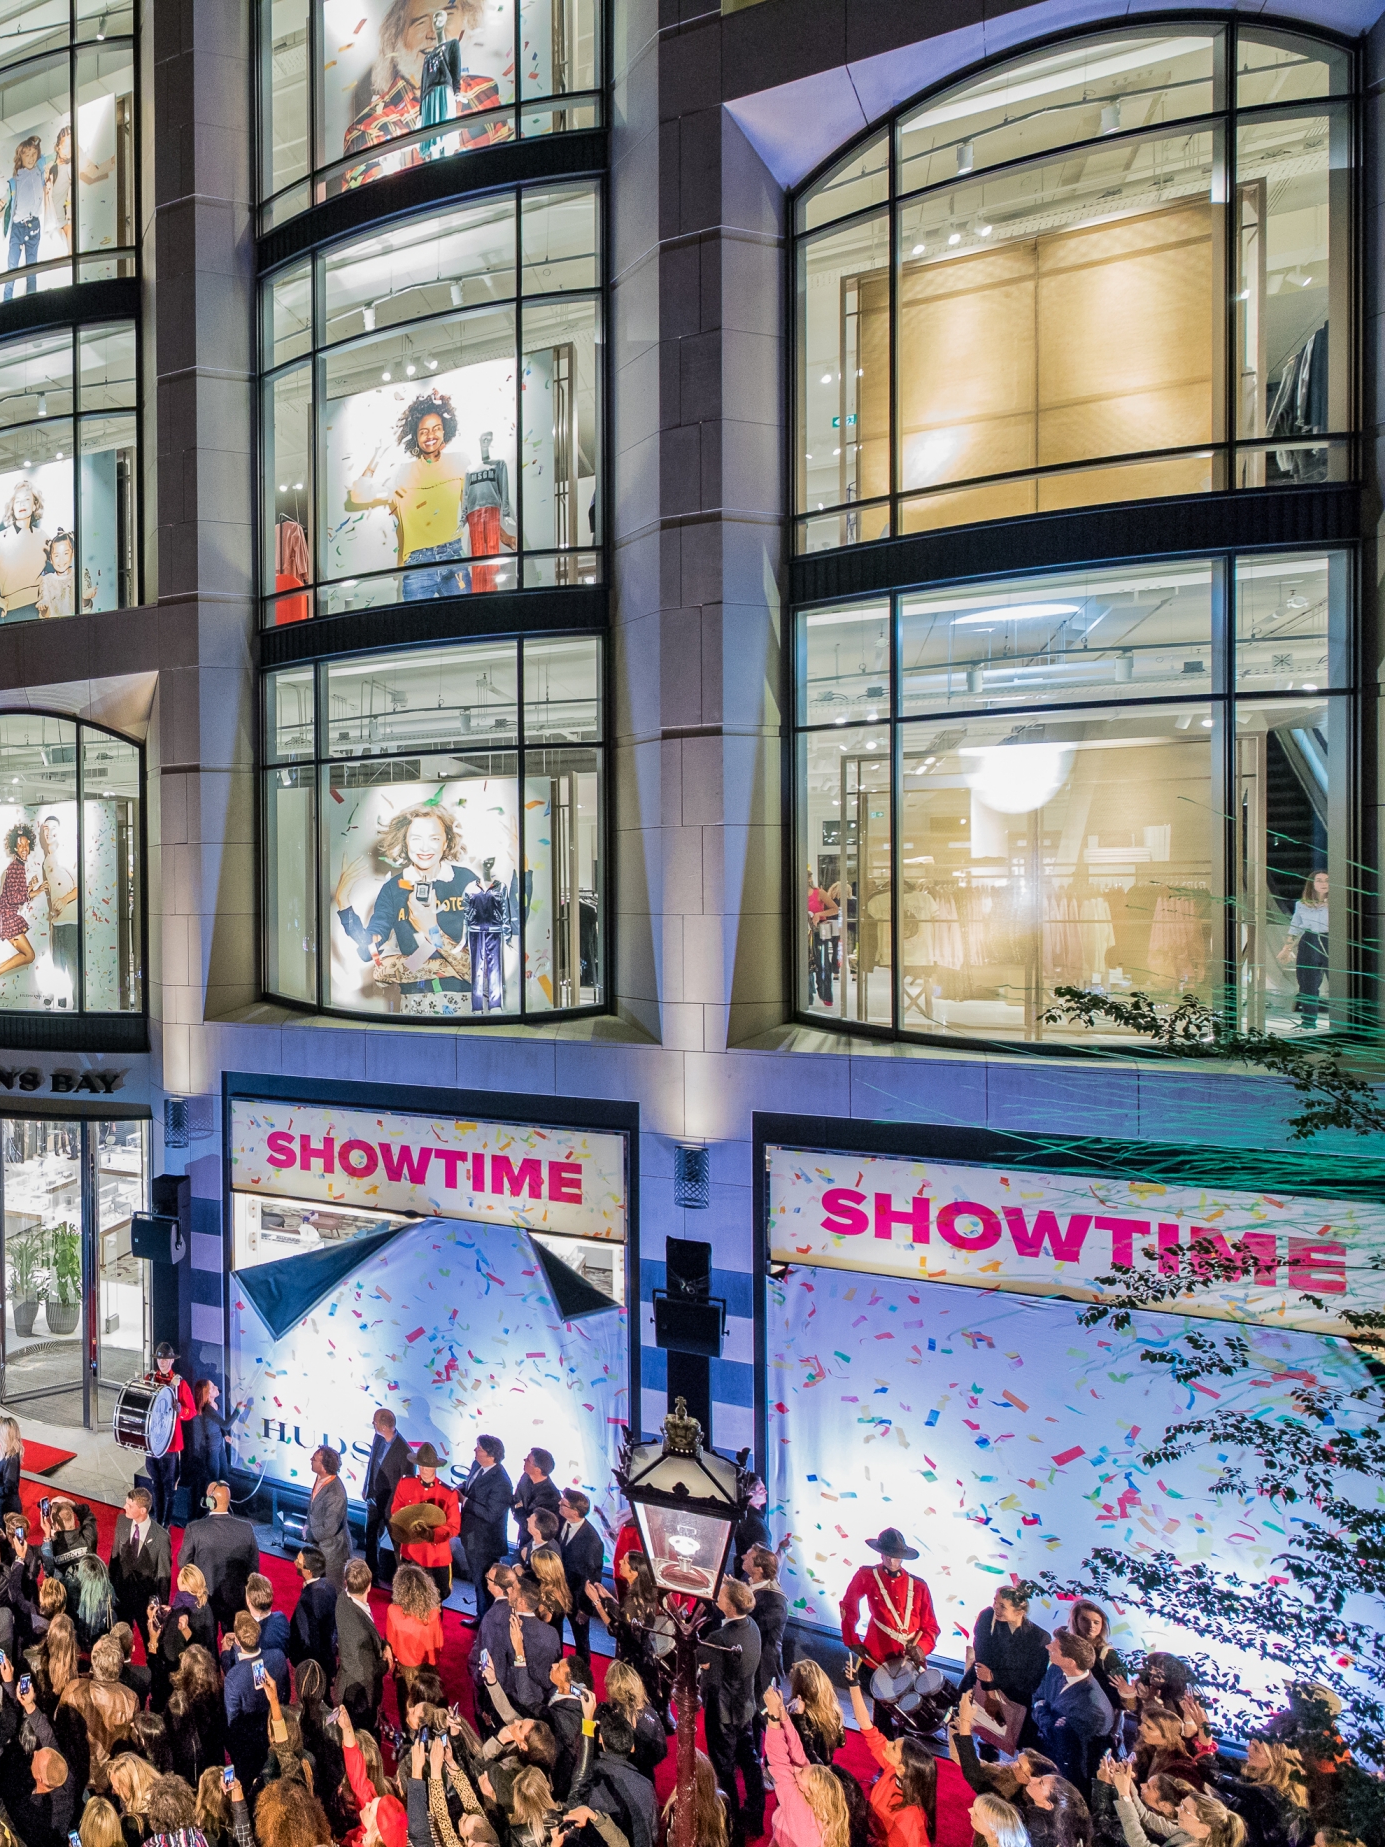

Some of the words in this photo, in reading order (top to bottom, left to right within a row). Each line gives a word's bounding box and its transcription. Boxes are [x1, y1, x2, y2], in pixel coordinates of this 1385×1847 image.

[471, 470, 494, 482] MSGM
[49, 1073, 120, 1094] BAY
[267, 1131, 582, 1205] SHOWTIME
[820, 1188, 1347, 1295] SHOWTIME
